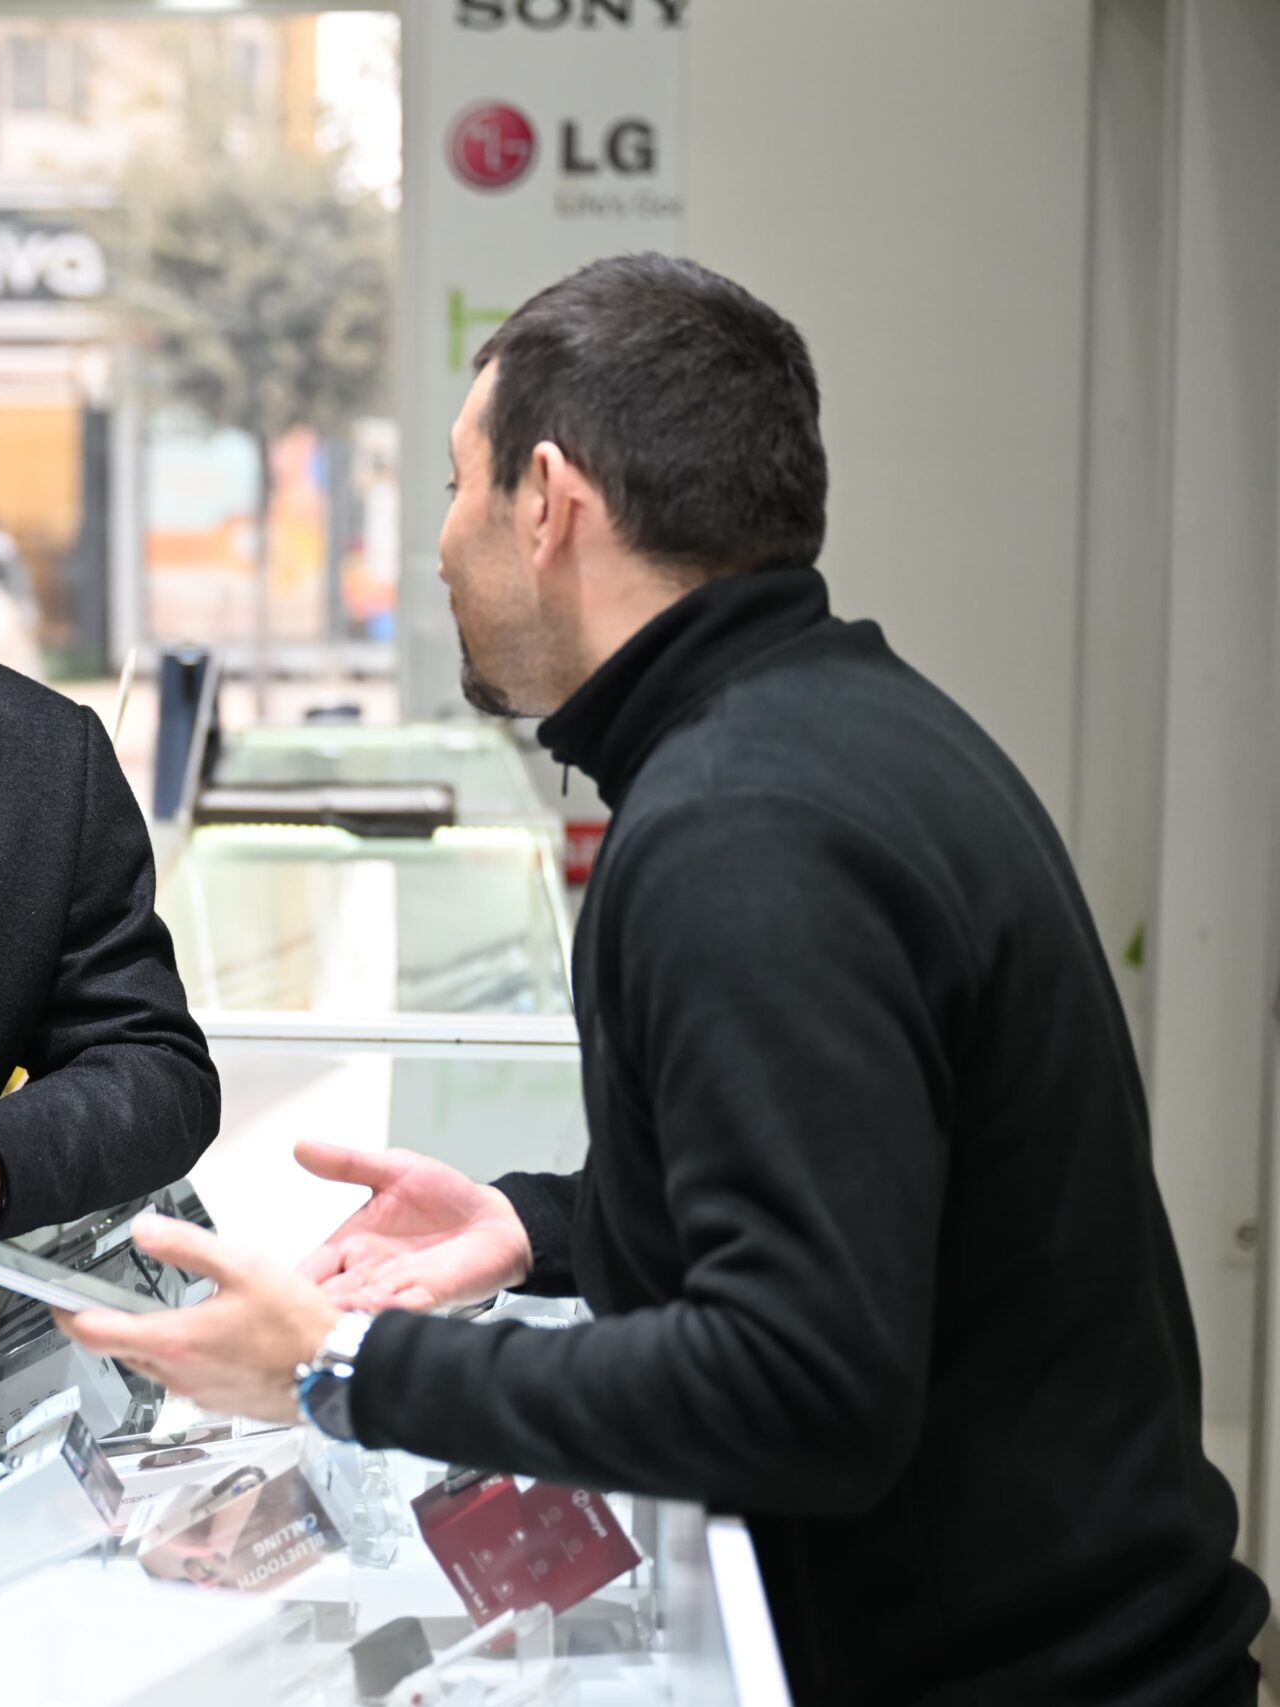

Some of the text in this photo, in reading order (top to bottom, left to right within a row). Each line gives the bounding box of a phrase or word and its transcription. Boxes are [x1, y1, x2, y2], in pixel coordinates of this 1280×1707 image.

[456, 0, 688, 31] SONY
[561, 116, 659, 175] LG
[236, 1531, 326, 1590] BLUETOOTH
[252, 1512, 317, 1559] CALLING
